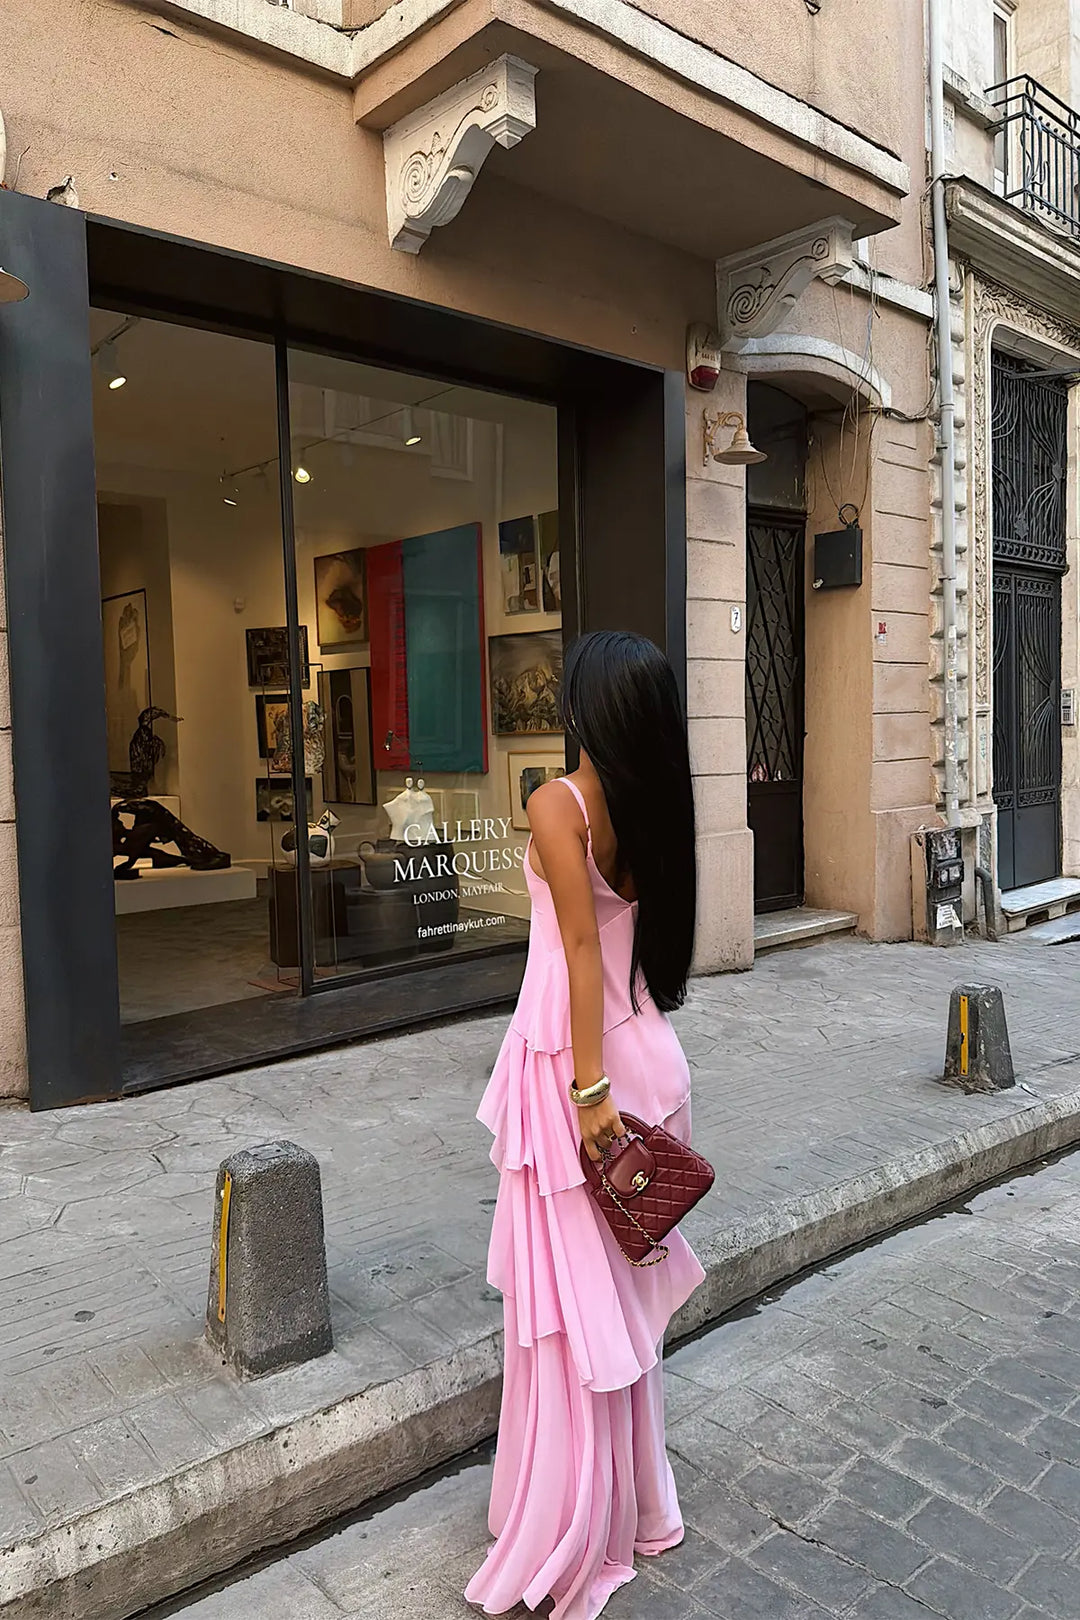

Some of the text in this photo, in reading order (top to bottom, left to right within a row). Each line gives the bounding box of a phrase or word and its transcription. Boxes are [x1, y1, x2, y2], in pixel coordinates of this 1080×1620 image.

[403, 817, 512, 848] GALLERY
[393, 846, 524, 883] MARQUESS
[413, 882, 506, 905] LONDON, MAYFAIR
[417, 915, 506, 939] fahrettinaykut.com
